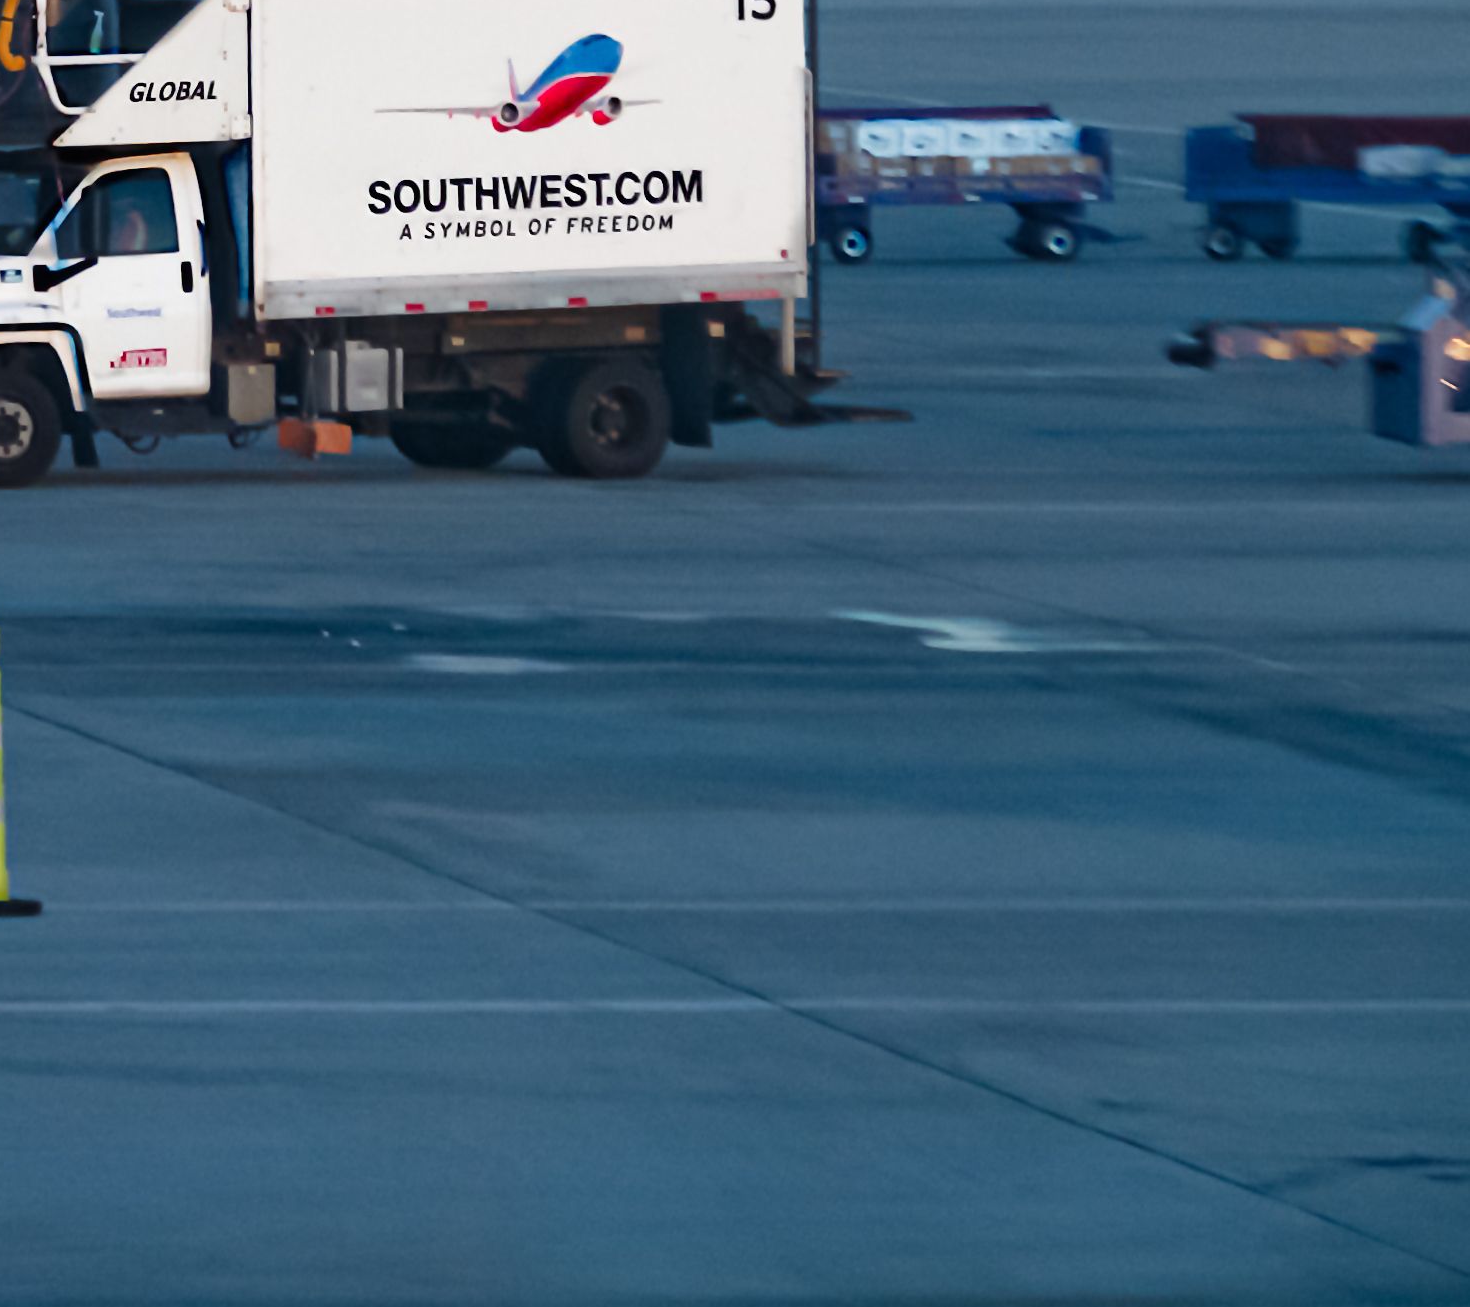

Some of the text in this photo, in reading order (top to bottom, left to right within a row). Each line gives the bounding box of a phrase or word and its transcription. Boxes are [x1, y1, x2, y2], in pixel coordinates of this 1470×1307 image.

[129, 80, 217, 102] GLOBAL
[368, 169, 703, 214] SOUTHWEST.COM
[399, 214, 674, 240] A SYMBOL OF FREEDOM
